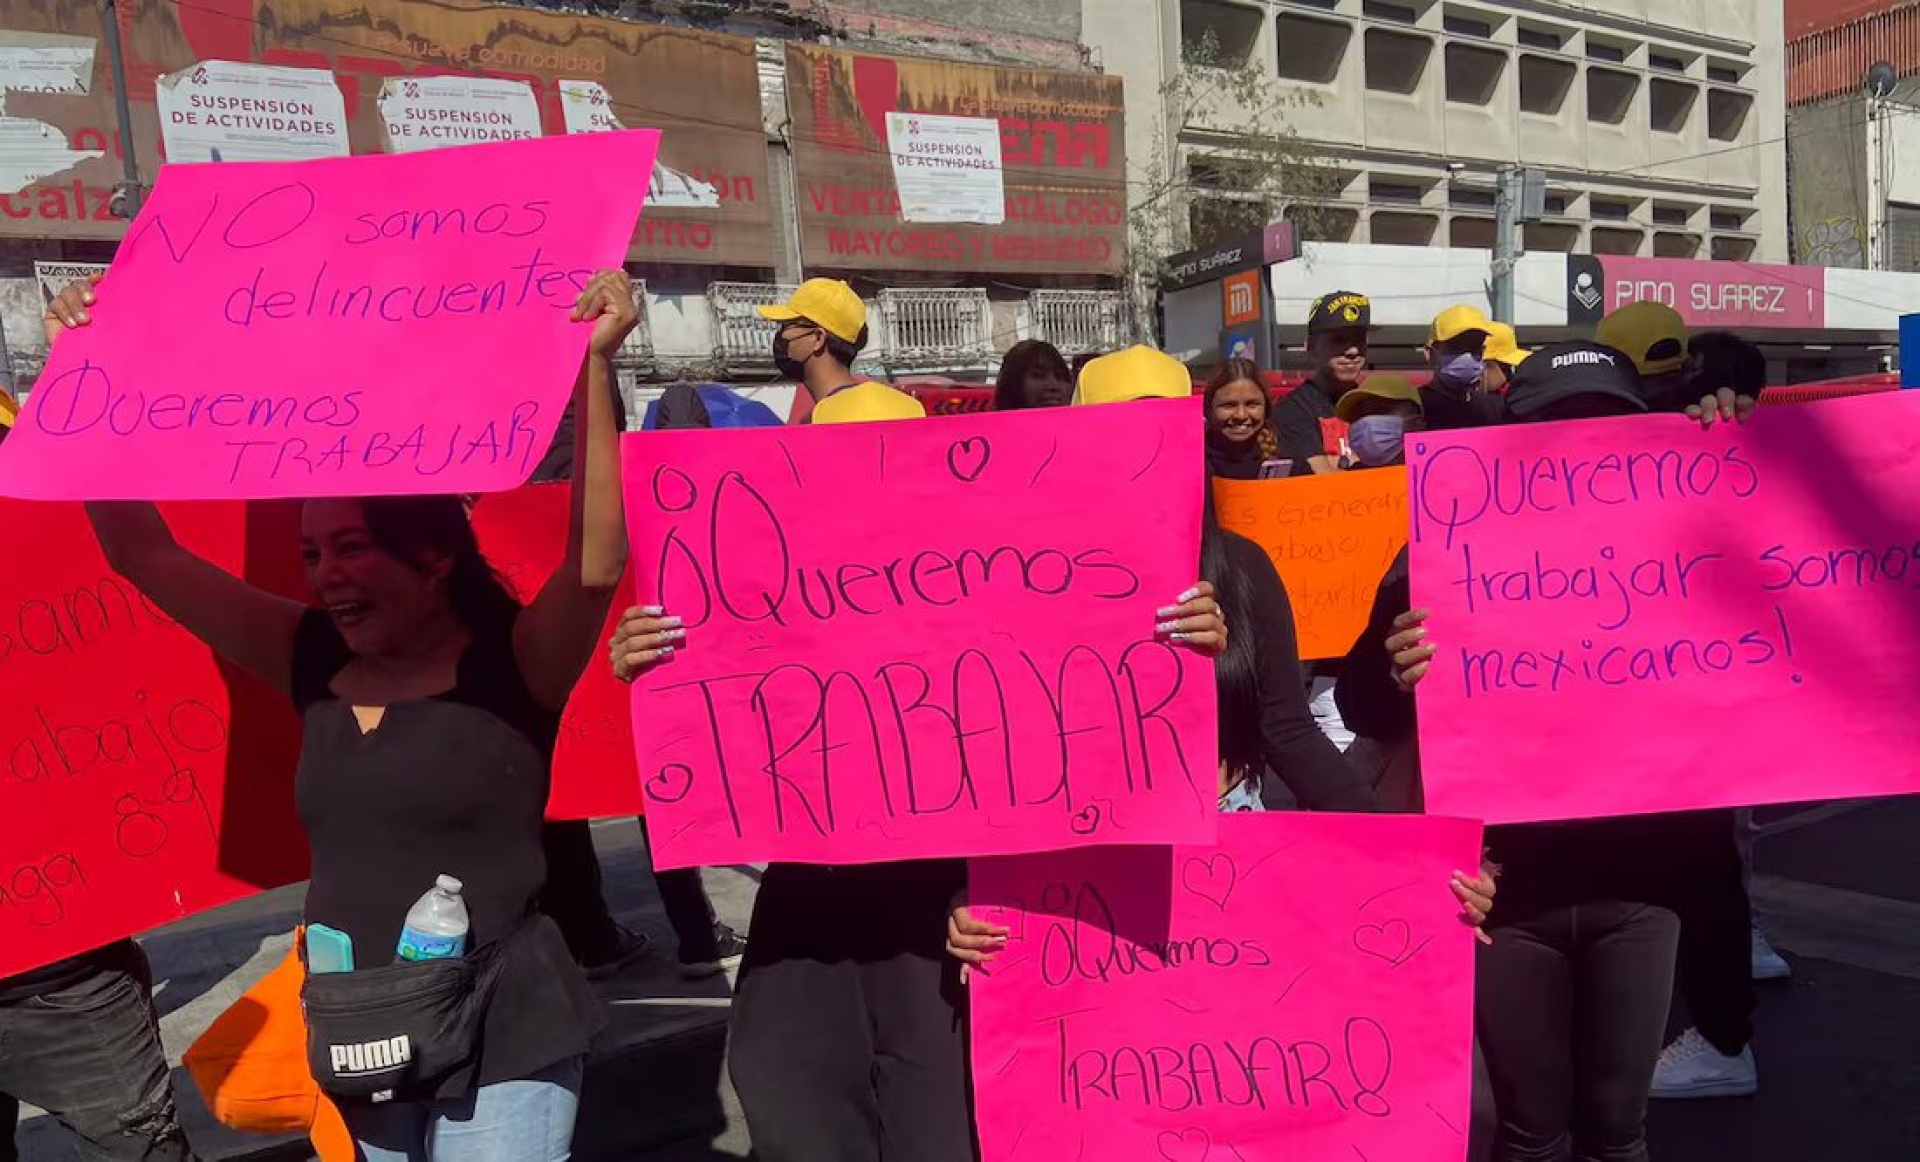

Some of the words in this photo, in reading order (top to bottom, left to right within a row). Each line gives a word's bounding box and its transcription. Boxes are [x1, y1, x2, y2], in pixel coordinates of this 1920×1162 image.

[172, 111, 198, 126] DE
[205, 114, 337, 136] ACTIVIDADES
[189, 94, 314, 117] SUSPENSIÓN
[404, 107, 514, 126] SUSPENSIÓN
[389, 124, 413, 137] DE
[418, 125, 533, 141] ACTIVIDADES
[896, 155, 914, 167] DE
[917, 155, 996, 170] ACTIVIDADES
[130, 182, 315, 263] NO
[345, 200, 552, 246] somos
[1615, 280, 1676, 310] PINO
[1690, 283, 1786, 314] SUAREZ
[1551, 350, 1600, 369] PUMA
[36, 358, 364, 437] Queremos
[225, 400, 540, 485] TRABAJAR
[1451, 543, 1724, 631] trabajar
[1461, 605, 1805, 699] mexicanos!
[648, 640, 1205, 838] TRABAJAR
[329, 1033, 412, 1073] PUMA
